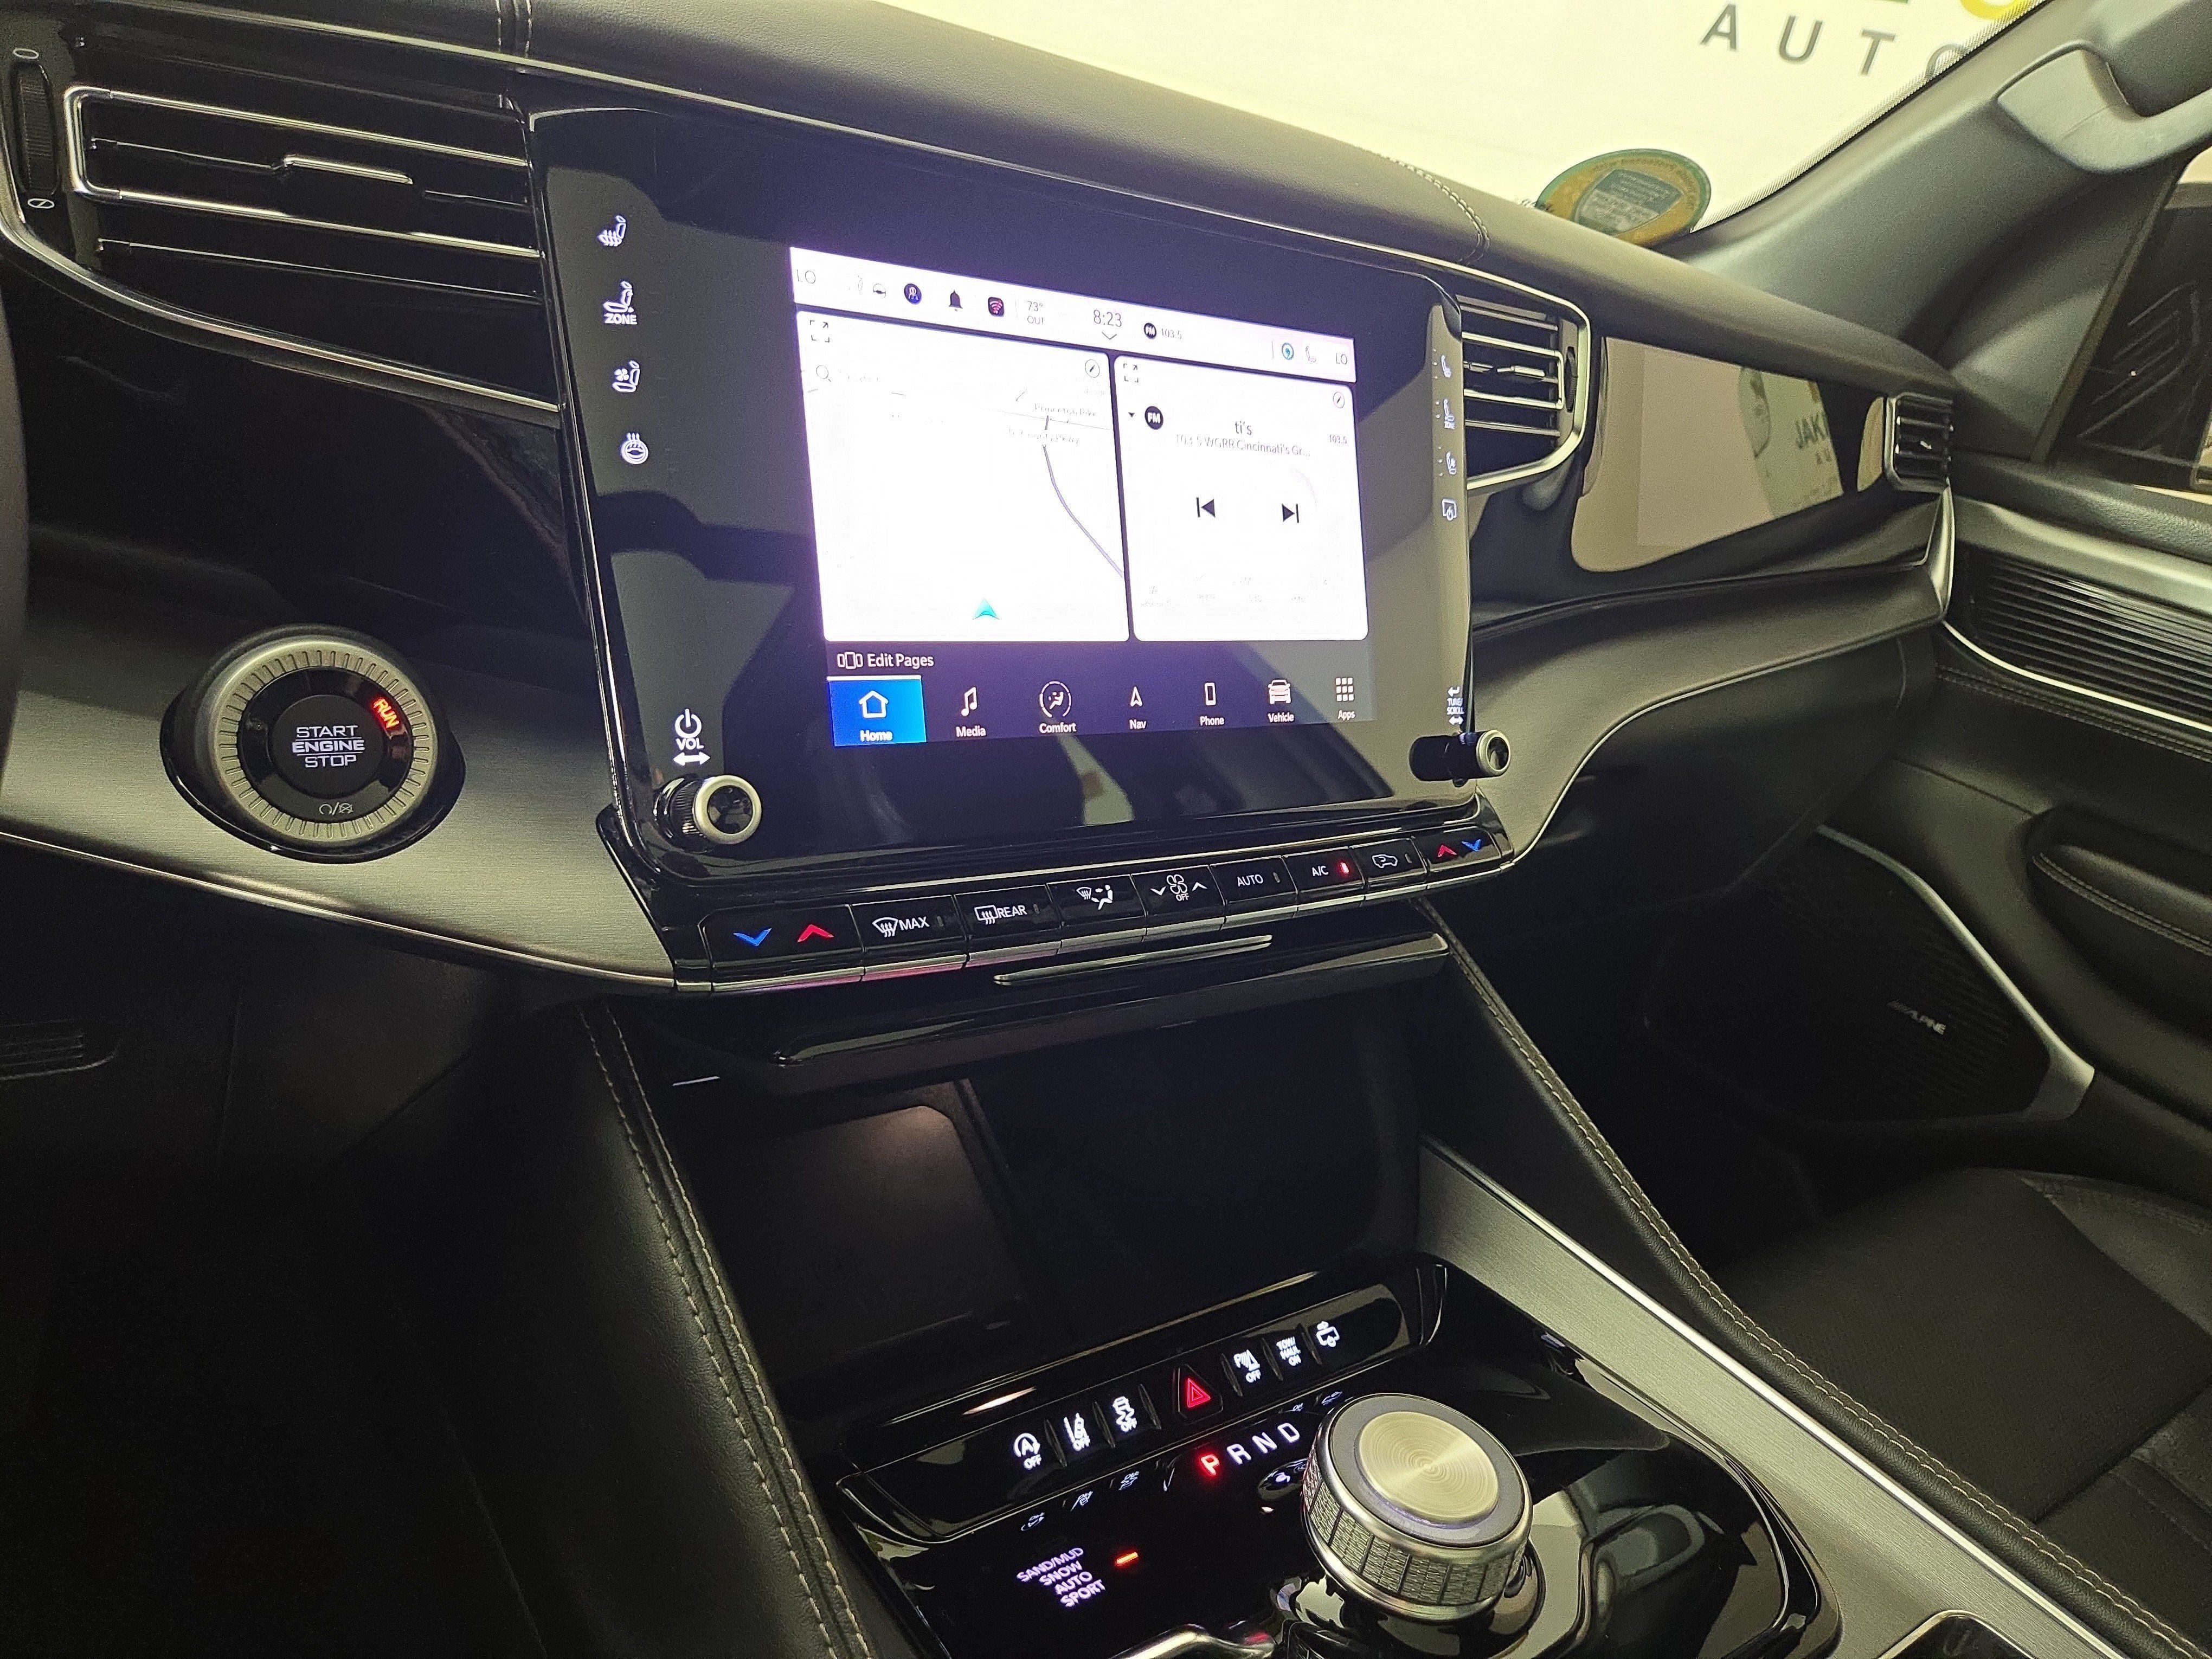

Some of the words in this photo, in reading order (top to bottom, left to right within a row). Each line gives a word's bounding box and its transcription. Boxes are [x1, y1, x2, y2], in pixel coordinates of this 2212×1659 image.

[604, 314, 638, 324] ZONE
[1093, 310, 1123, 327] 8:23
[1335, 352, 1348, 365] LO
[1147, 412, 1161, 423] FM
[1234, 420, 1252, 435] ti's
[1204, 436, 1234, 449] WGRR
[1236, 440, 1290, 455] Cincinnati's
[1329, 435, 1347, 445] 103.5
[867, 654, 893, 667] Edit
[896, 654, 934, 670] Pages
[373, 698, 400, 728] RUN
[1268, 712, 1295, 723] Vehicle
[1338, 710, 1355, 721] Apps
[1129, 719, 1147, 729] Nav
[1200, 716, 1225, 726] Phone
[297, 726, 358, 738] START
[956, 726, 986, 737] Media
[1039, 723, 1077, 734] Comfort
[860, 730, 892, 742] Home
[292, 740, 365, 753] ENGINE
[676, 738, 704, 750] VOL
[305, 755, 357, 768] STOP
[1312, 866, 1329, 876] A/C
[1237, 874, 1264, 888] AUTO
[1175, 892, 1189, 902] OFF
[998, 905, 1027, 918] REAR
[900, 916, 930, 930] MAX
[1245, 1369, 1262, 1382] OFF
[1200, 1454, 1219, 1475] P
[1227, 1443, 1251, 1464] R
[1252, 1432, 1277, 1454] N
[1277, 1423, 1300, 1443] D
[1024, 1454, 1042, 1470] OFF
[1017, 1547, 1084, 1582] SAND/MUD
[1039, 1561, 1083, 1586] SNOW
[1054, 1571, 1093, 1596] AUTO
[1060, 1579, 1106, 1608] SPORT
